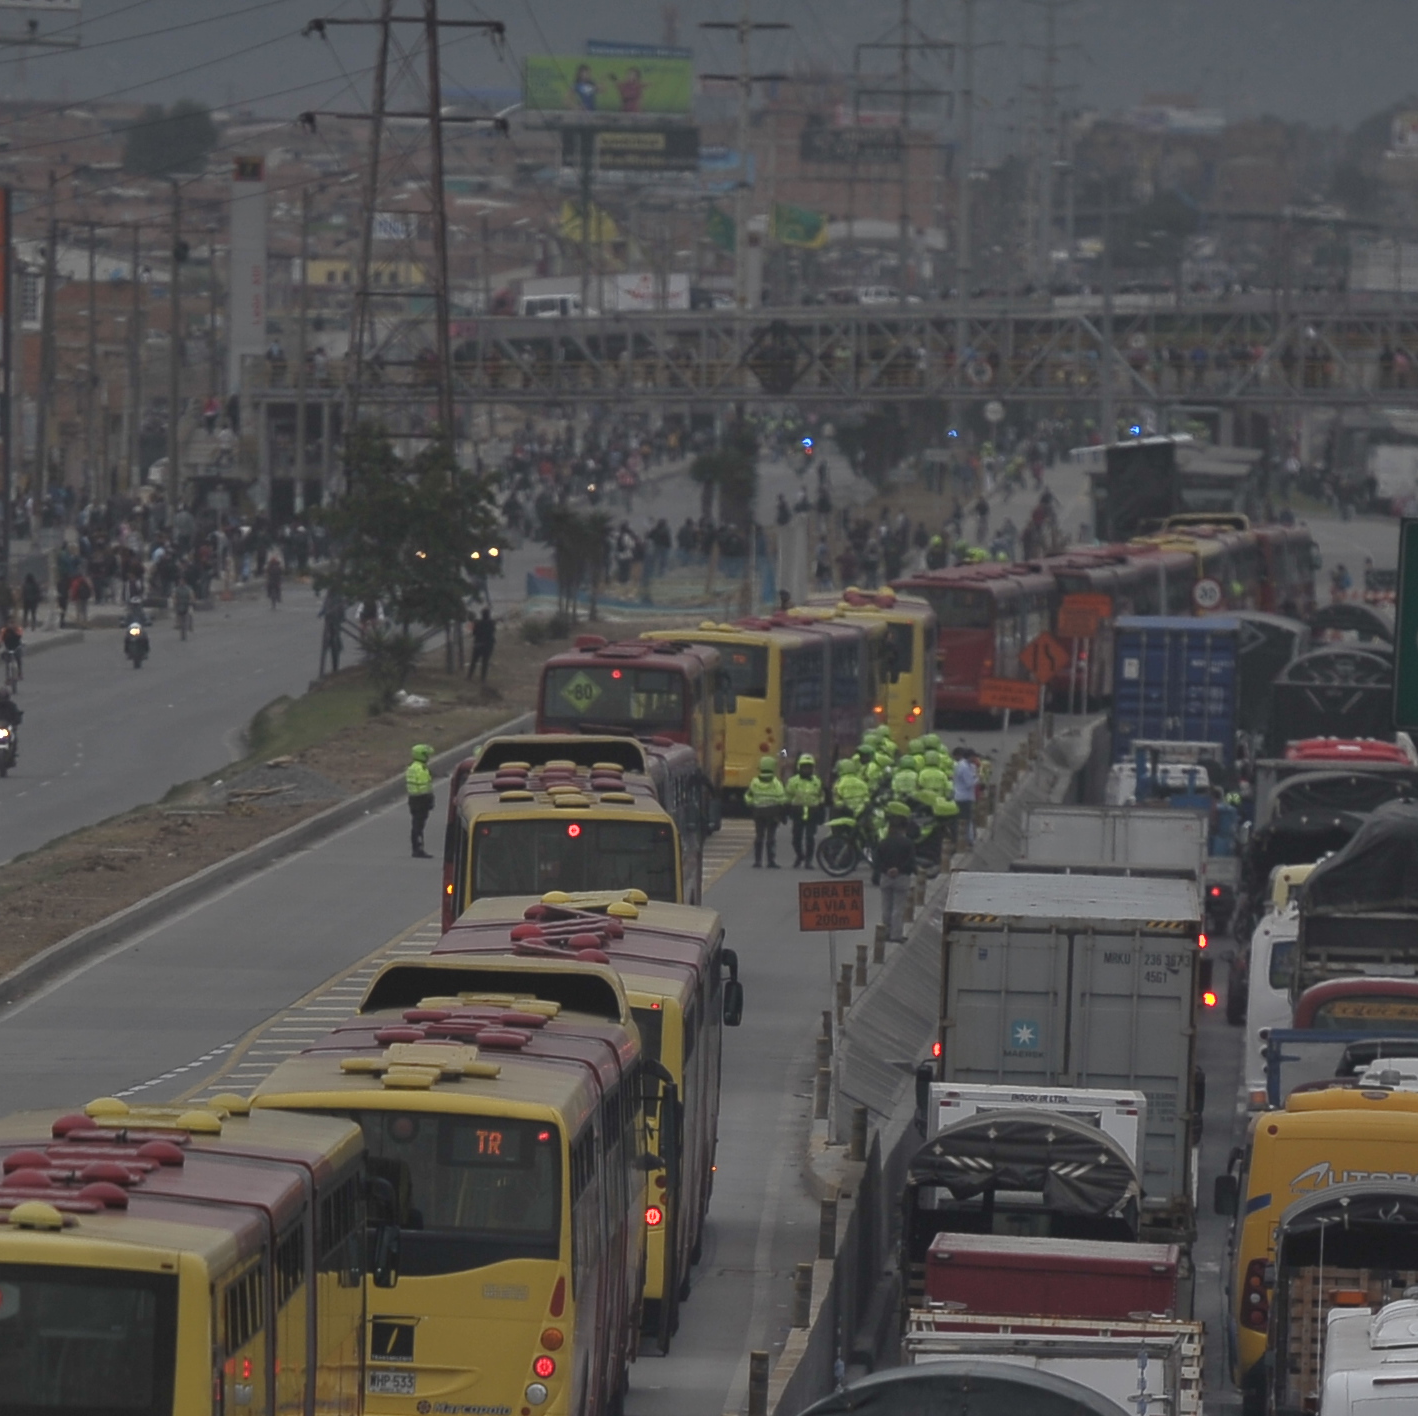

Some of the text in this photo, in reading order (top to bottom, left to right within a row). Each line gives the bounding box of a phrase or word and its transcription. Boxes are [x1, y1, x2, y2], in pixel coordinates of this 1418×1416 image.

[803, 885, 861, 899] OBRA EN
[803, 899, 861, 912] LA VIA A
[814, 913, 851, 926] 200m
[1103, 952, 1131, 965] MRKU
[475, 1130, 502, 1155] TR
[432, 1402, 512, 1416] Marcopolo
